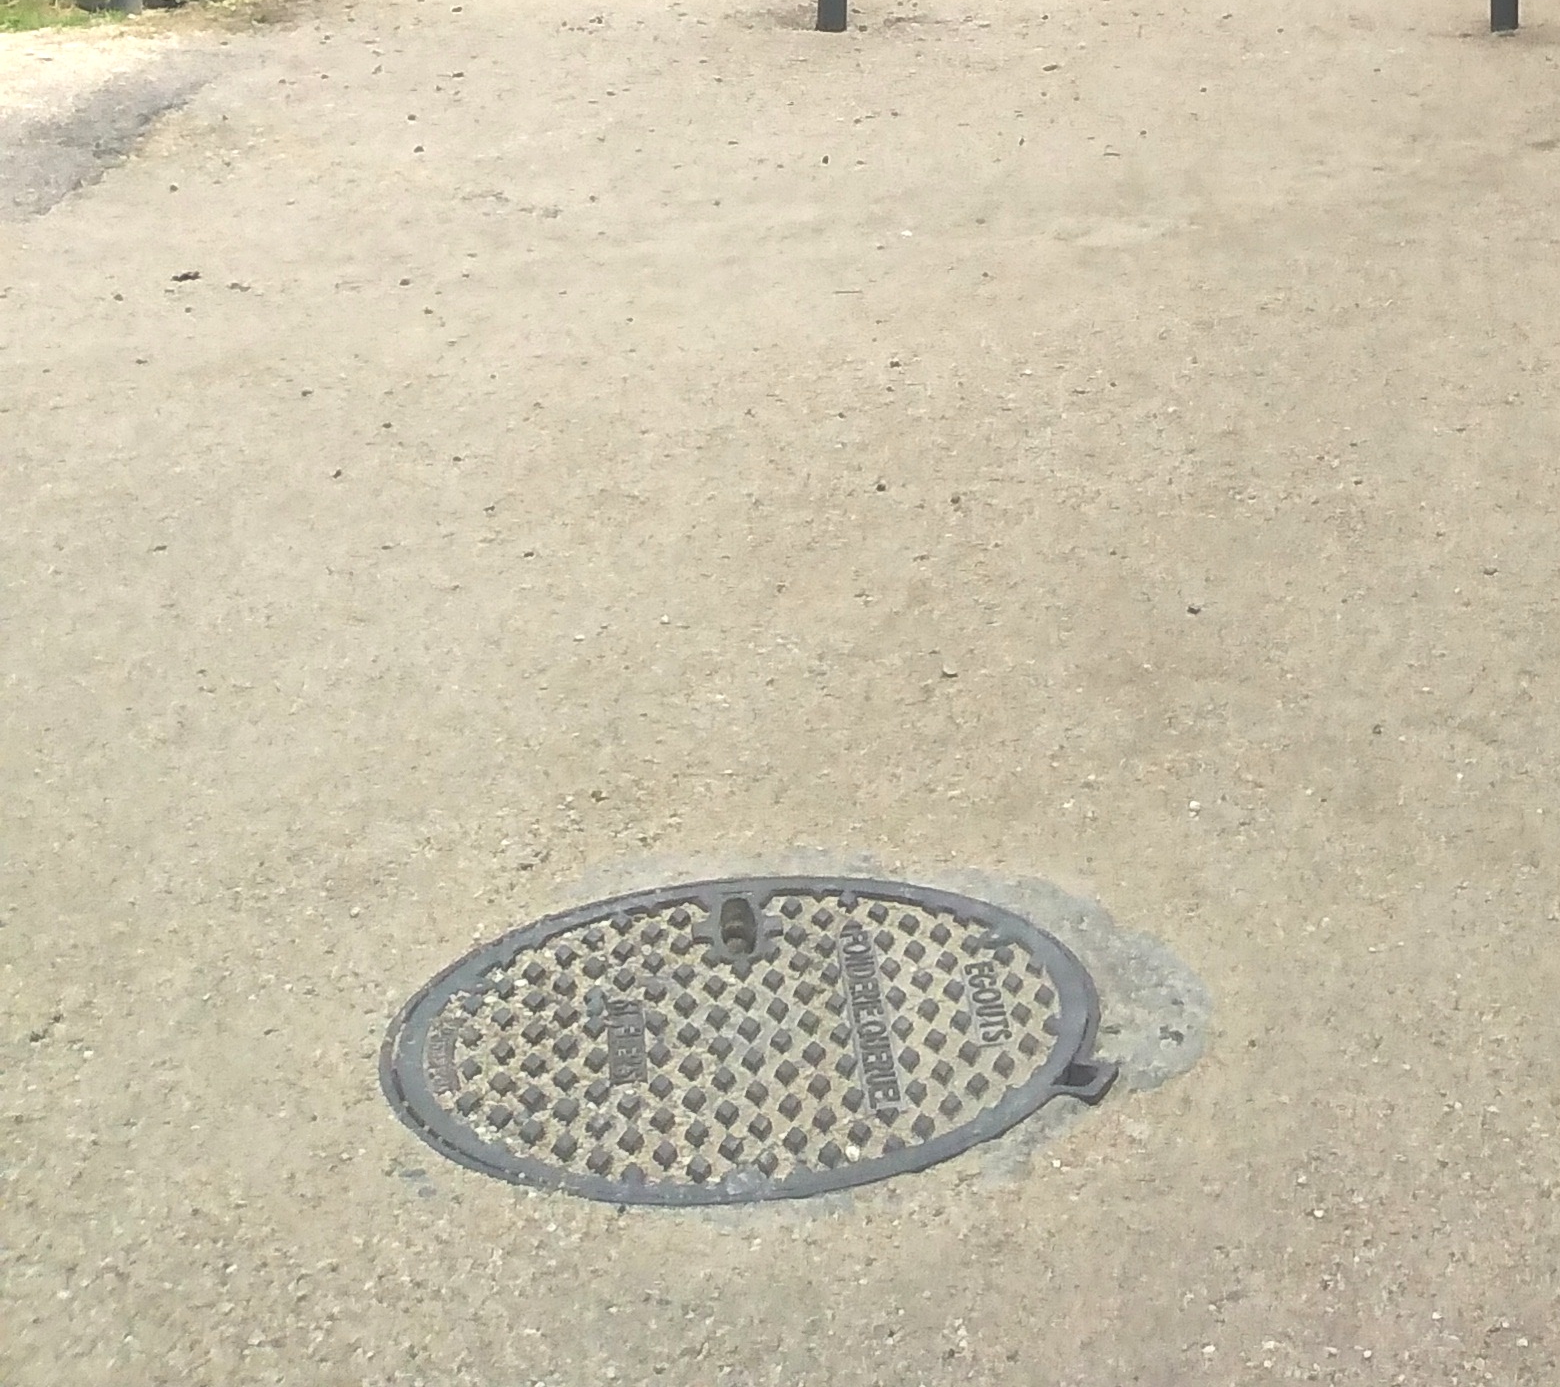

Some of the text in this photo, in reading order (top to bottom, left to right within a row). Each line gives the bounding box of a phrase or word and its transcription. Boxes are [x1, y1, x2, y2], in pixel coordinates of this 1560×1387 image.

[840, 929, 902, 1110] FONDERIE QUERUEL
[963, 960, 1013, 1043] EGOUTS
